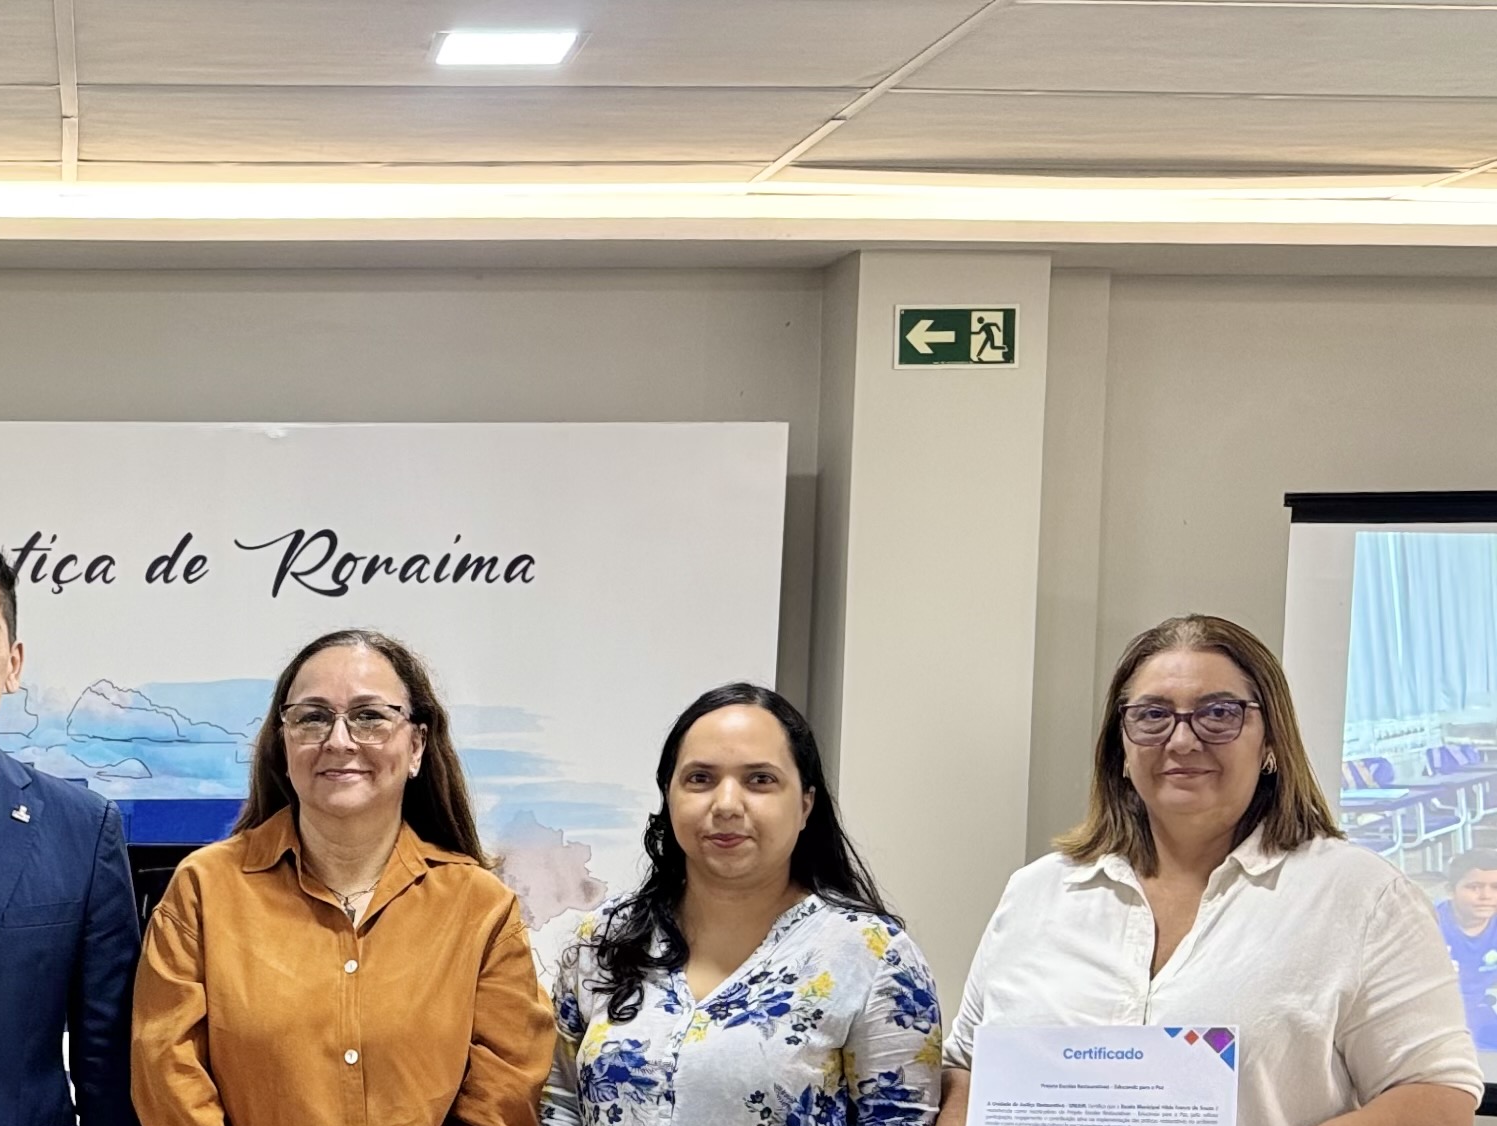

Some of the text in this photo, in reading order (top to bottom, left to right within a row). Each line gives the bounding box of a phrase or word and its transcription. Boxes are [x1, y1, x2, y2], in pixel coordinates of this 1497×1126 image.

[144, 531, 210, 584] de
[234, 527, 536, 598] Roraima
[1063, 1047, 1144, 1060] Certificado
